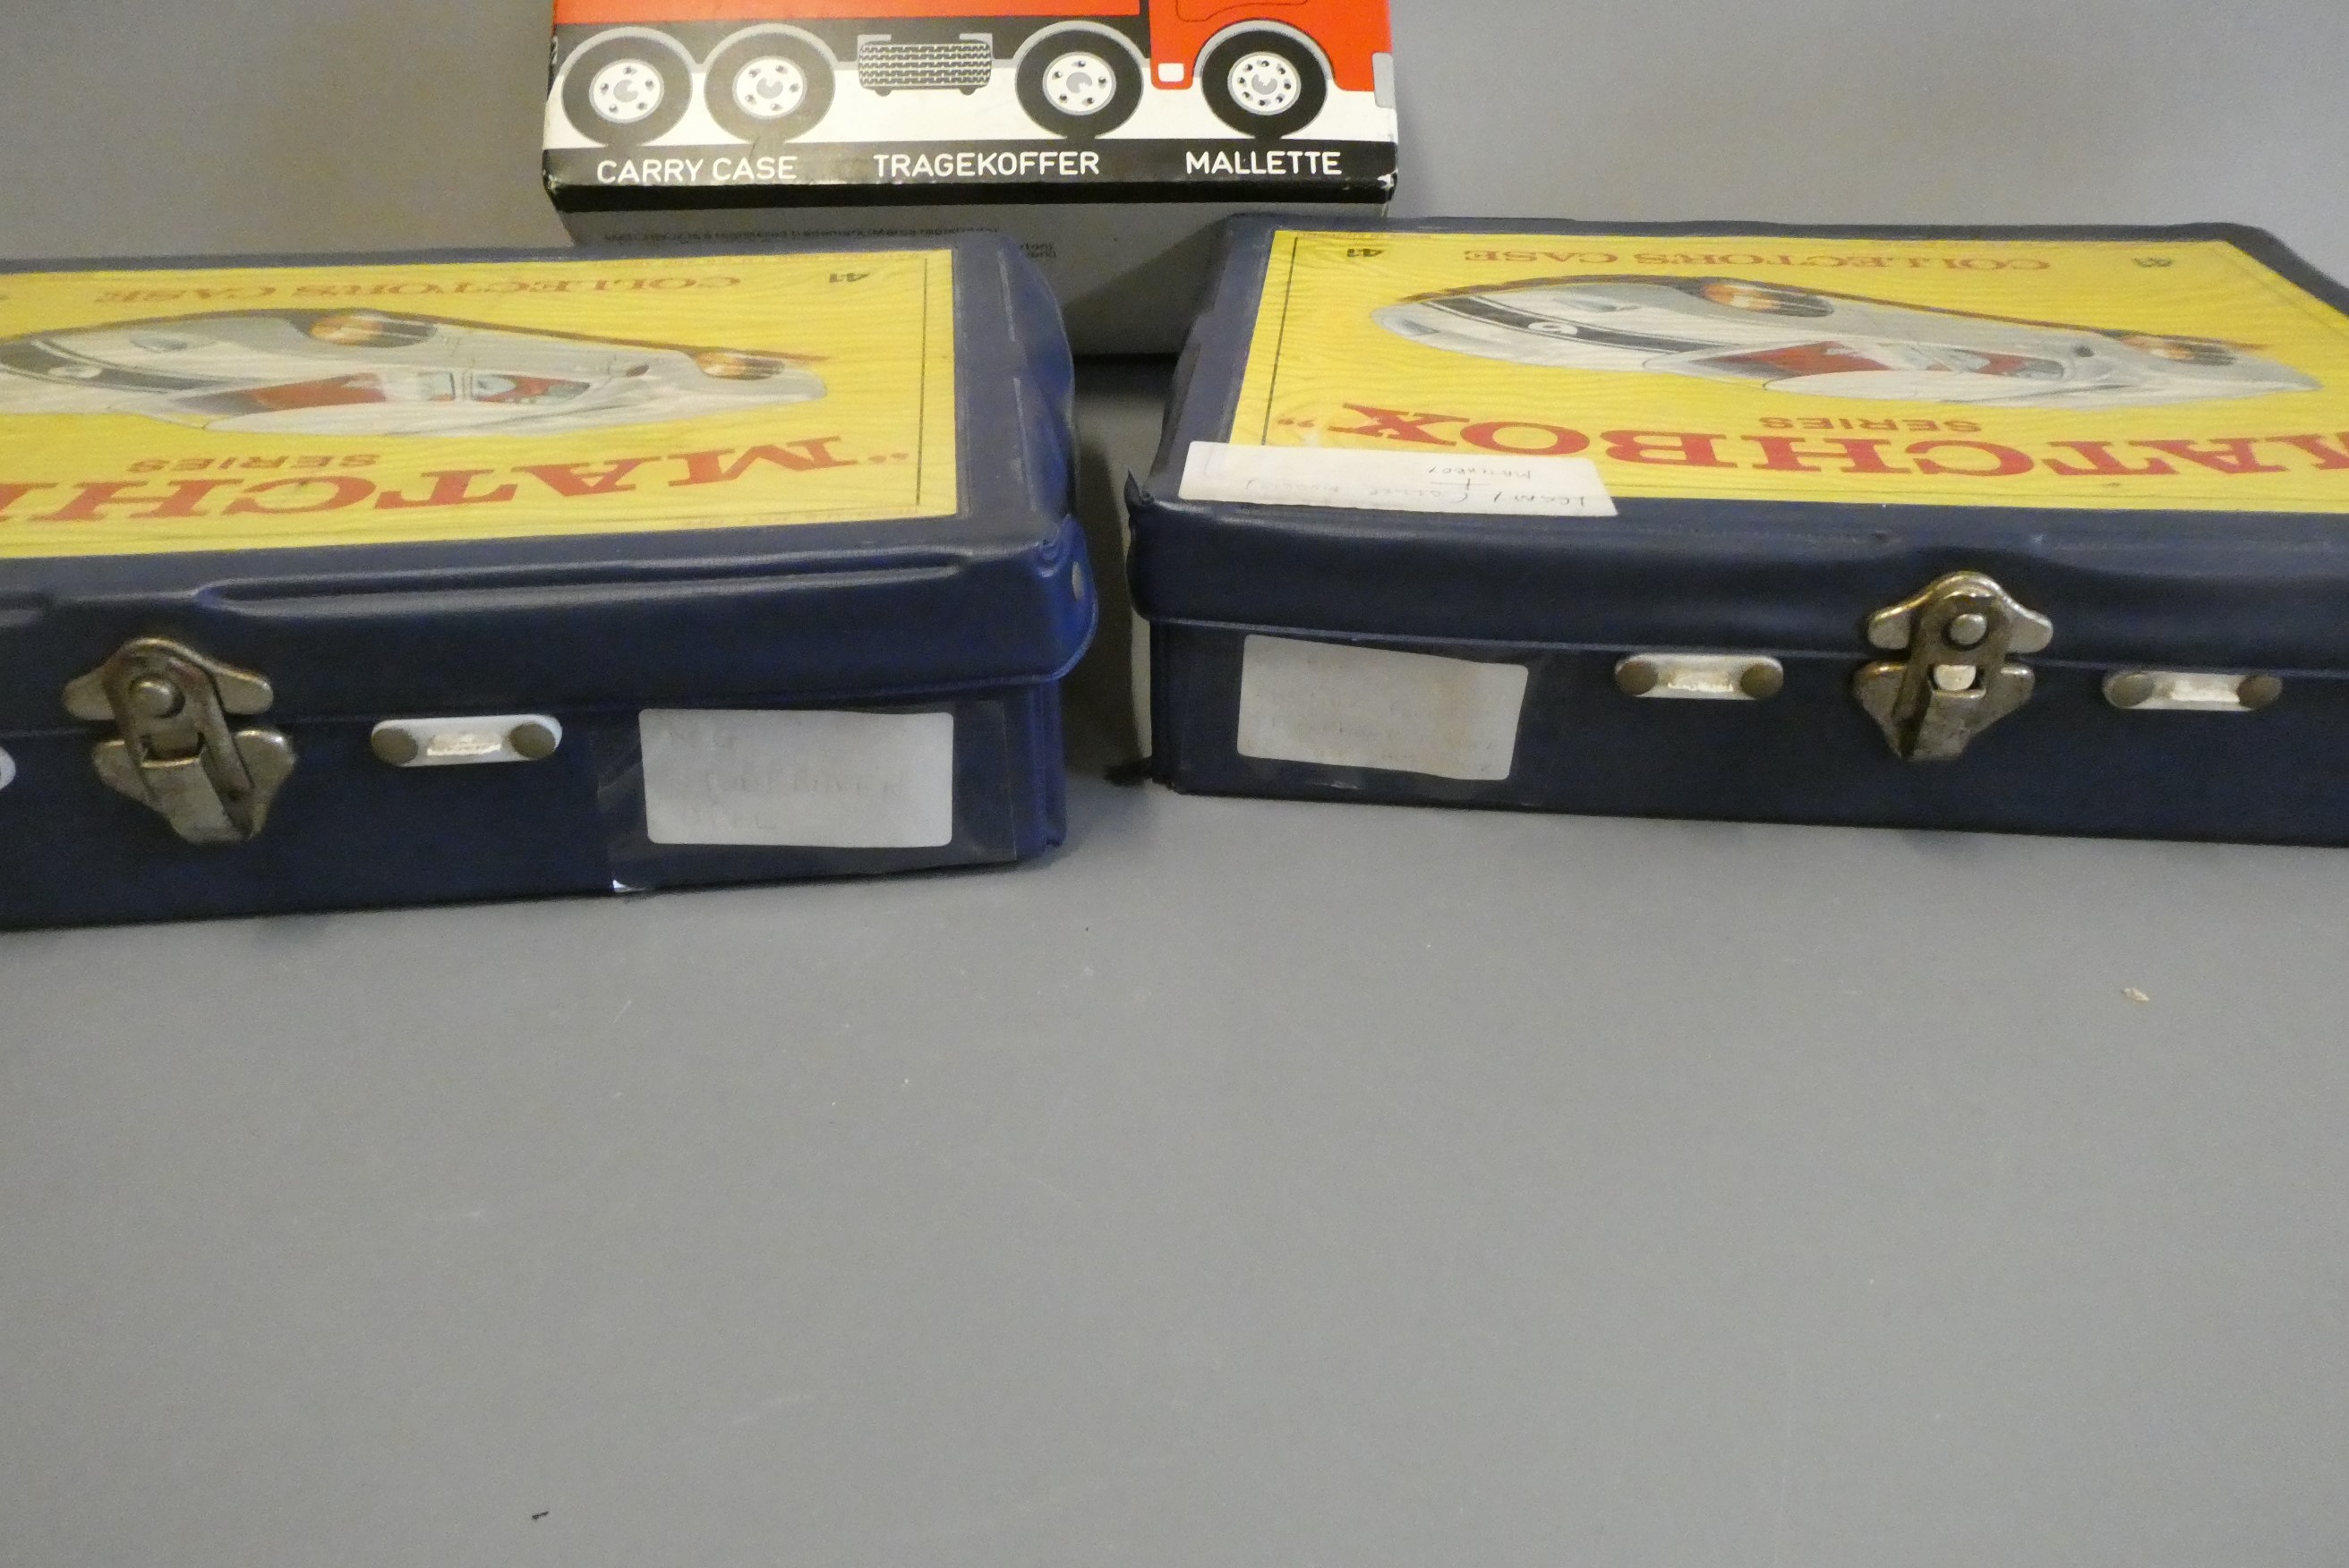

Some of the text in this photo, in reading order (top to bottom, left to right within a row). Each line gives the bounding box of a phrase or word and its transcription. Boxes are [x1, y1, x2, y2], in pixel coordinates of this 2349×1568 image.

[596, 155, 799, 184] CARRY CASE
[873, 150, 1101, 178] TRAGEKOFFER
[1185, 150, 1344, 175] MALLETTE
[1463, 250, 1619, 265] CASE
[1758, 416, 1982, 433] SERIES
[125, 453, 380, 473] SERIES
